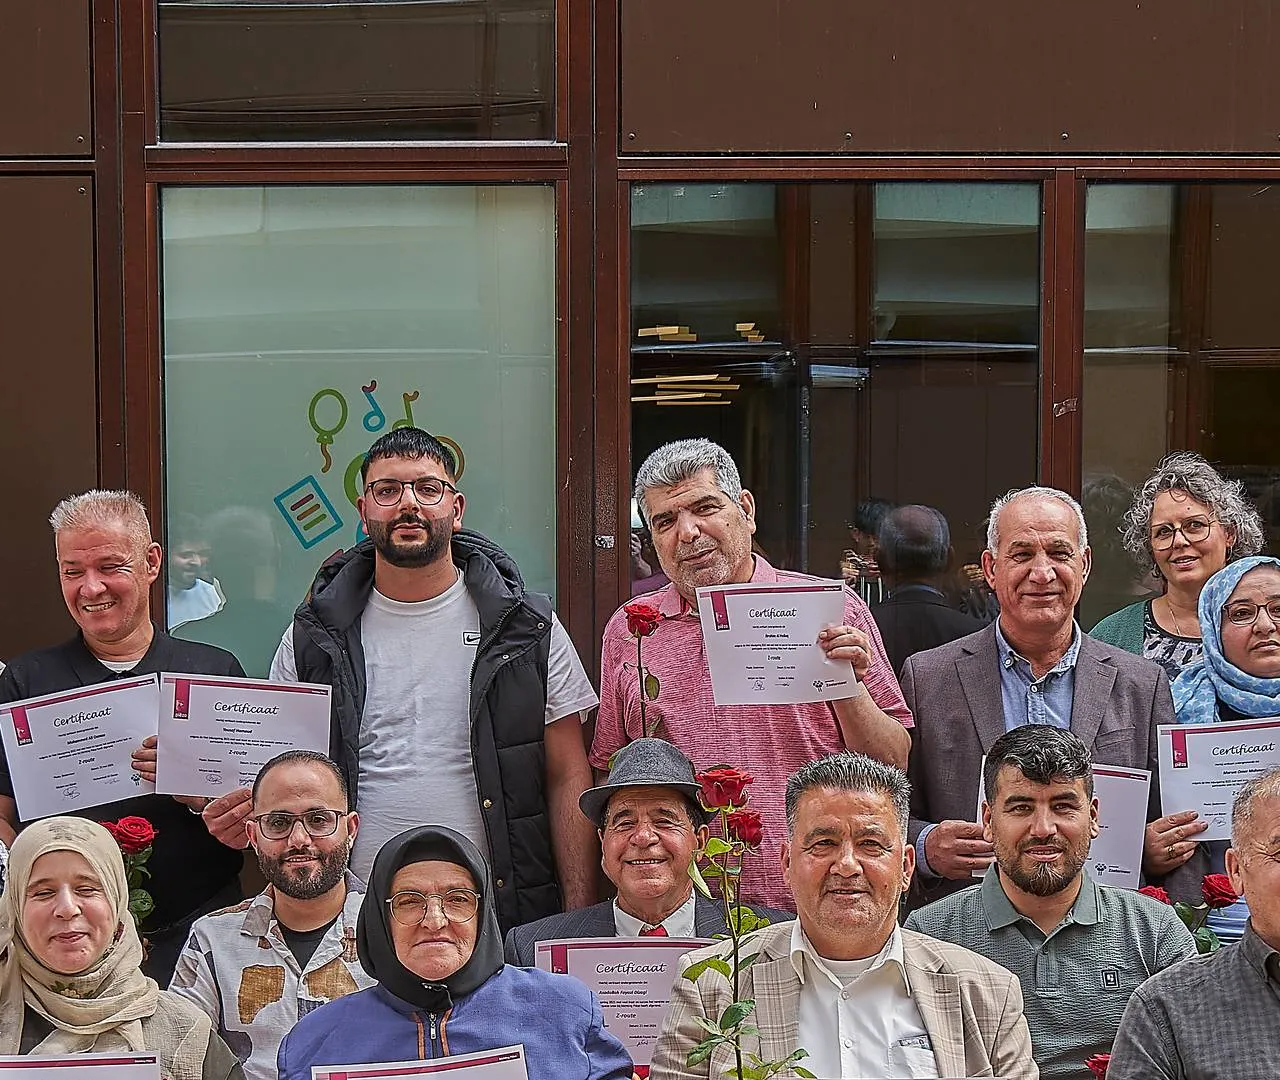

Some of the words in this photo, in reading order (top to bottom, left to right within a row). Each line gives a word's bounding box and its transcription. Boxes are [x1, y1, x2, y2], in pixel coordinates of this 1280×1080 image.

[749, 607, 797, 619] Certificaat
[214, 701, 280, 715] Certificaat
[53, 707, 111, 727] Certificaat
[1212, 742, 1276, 756] Certificaat
[596, 962, 667, 975] Certificaat
